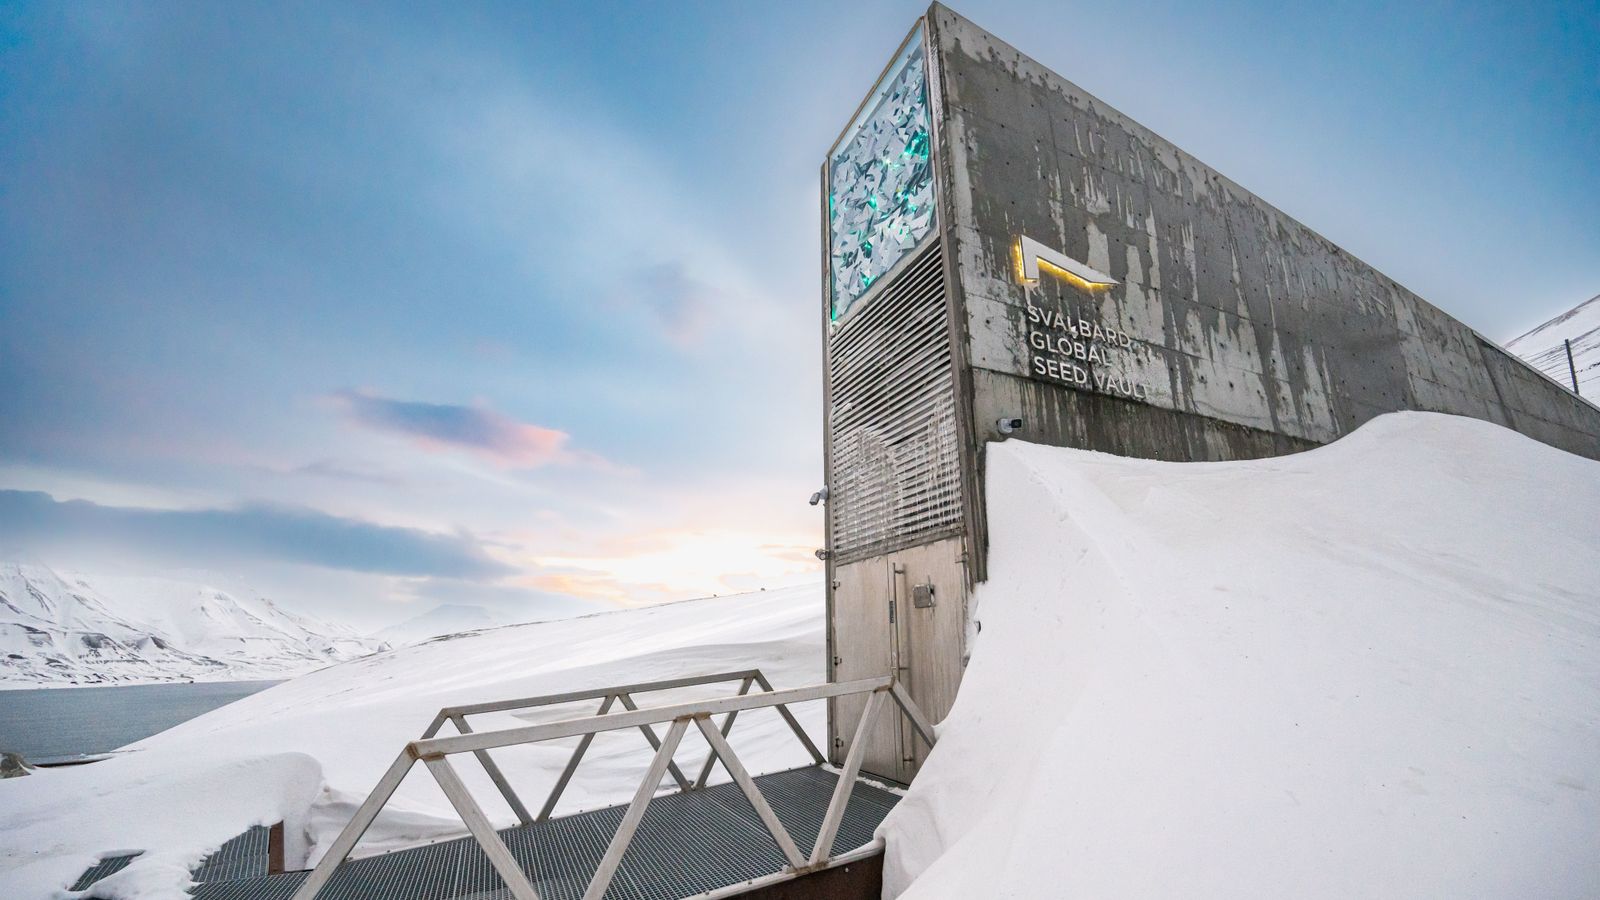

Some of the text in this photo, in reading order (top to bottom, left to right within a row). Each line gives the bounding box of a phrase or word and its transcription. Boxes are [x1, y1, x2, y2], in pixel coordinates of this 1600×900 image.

[1028, 305, 1131, 348] SVALBARD
[1030, 331, 1113, 367] GLOBAL
[1034, 356, 1151, 399] SEED VAULT
